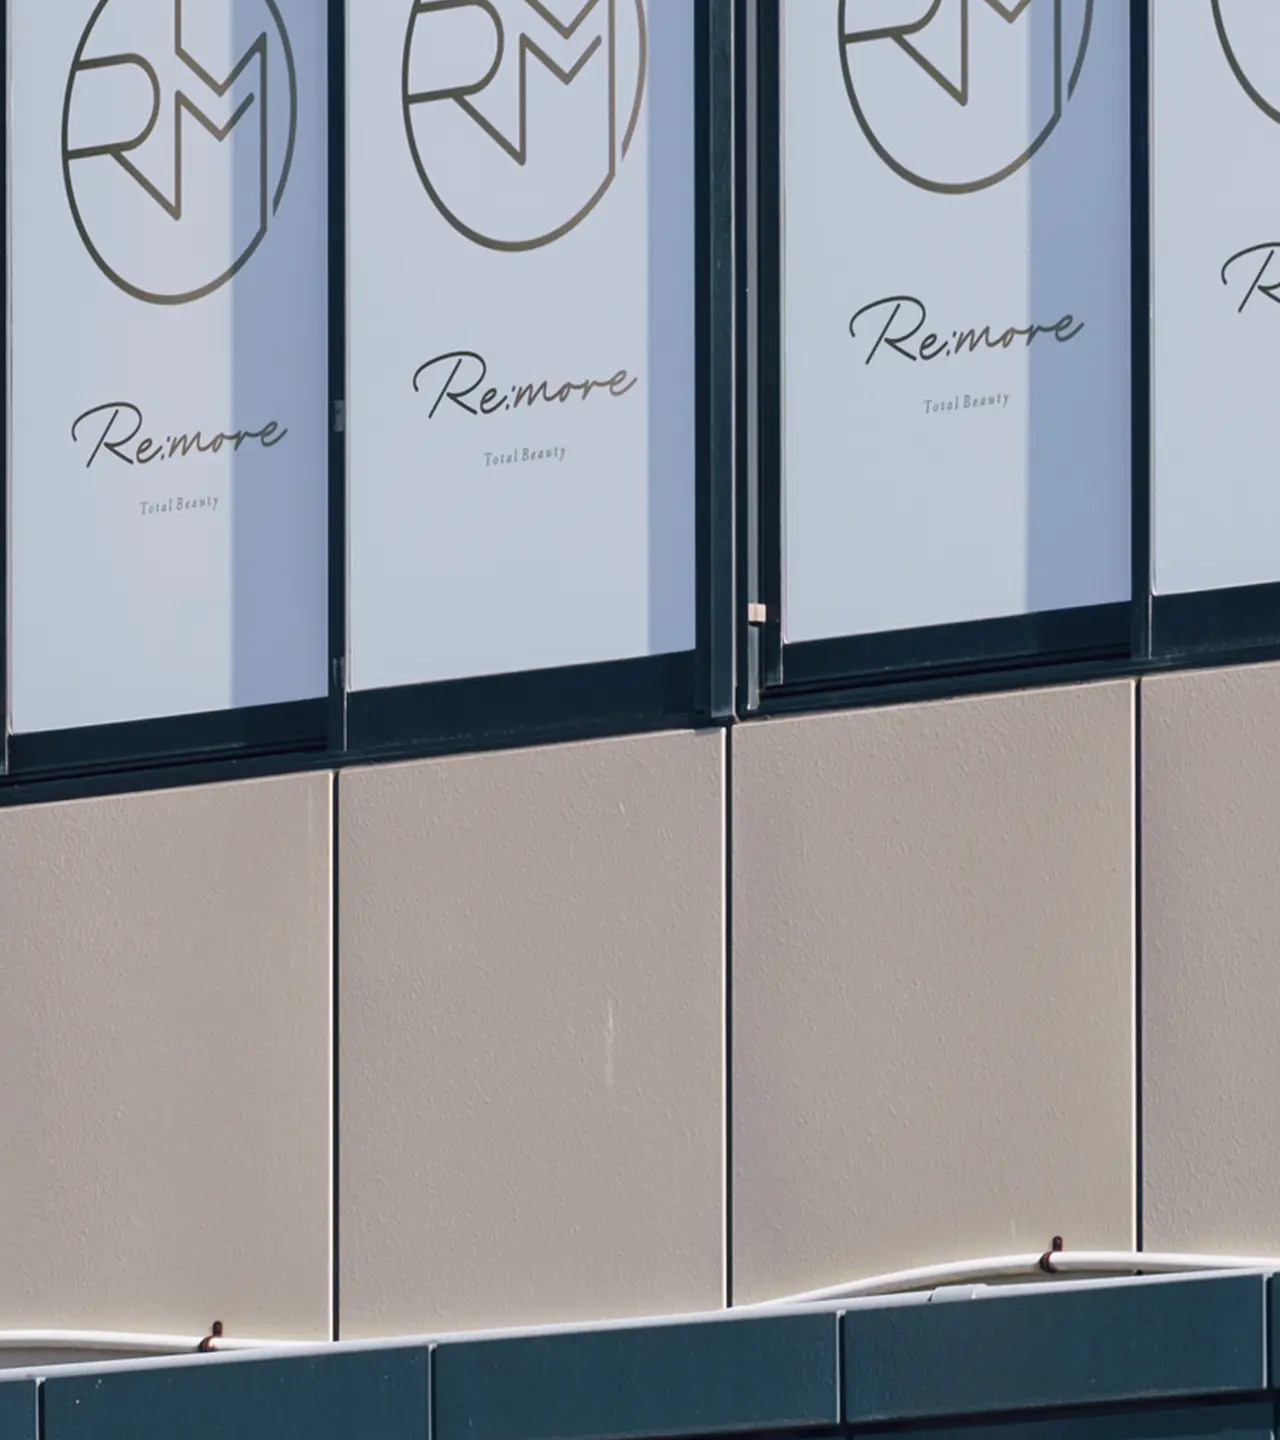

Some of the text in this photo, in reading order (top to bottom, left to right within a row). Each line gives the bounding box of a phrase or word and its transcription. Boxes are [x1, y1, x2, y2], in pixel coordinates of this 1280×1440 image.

[849, 294, 1085, 366] Re:more
[412, 350, 638, 420] Re:more
[923, 395, 960, 415] Total
[71, 401, 288, 469] Re:more
[483, 448, 518, 467] Total
[139, 497, 173, 516] Total
